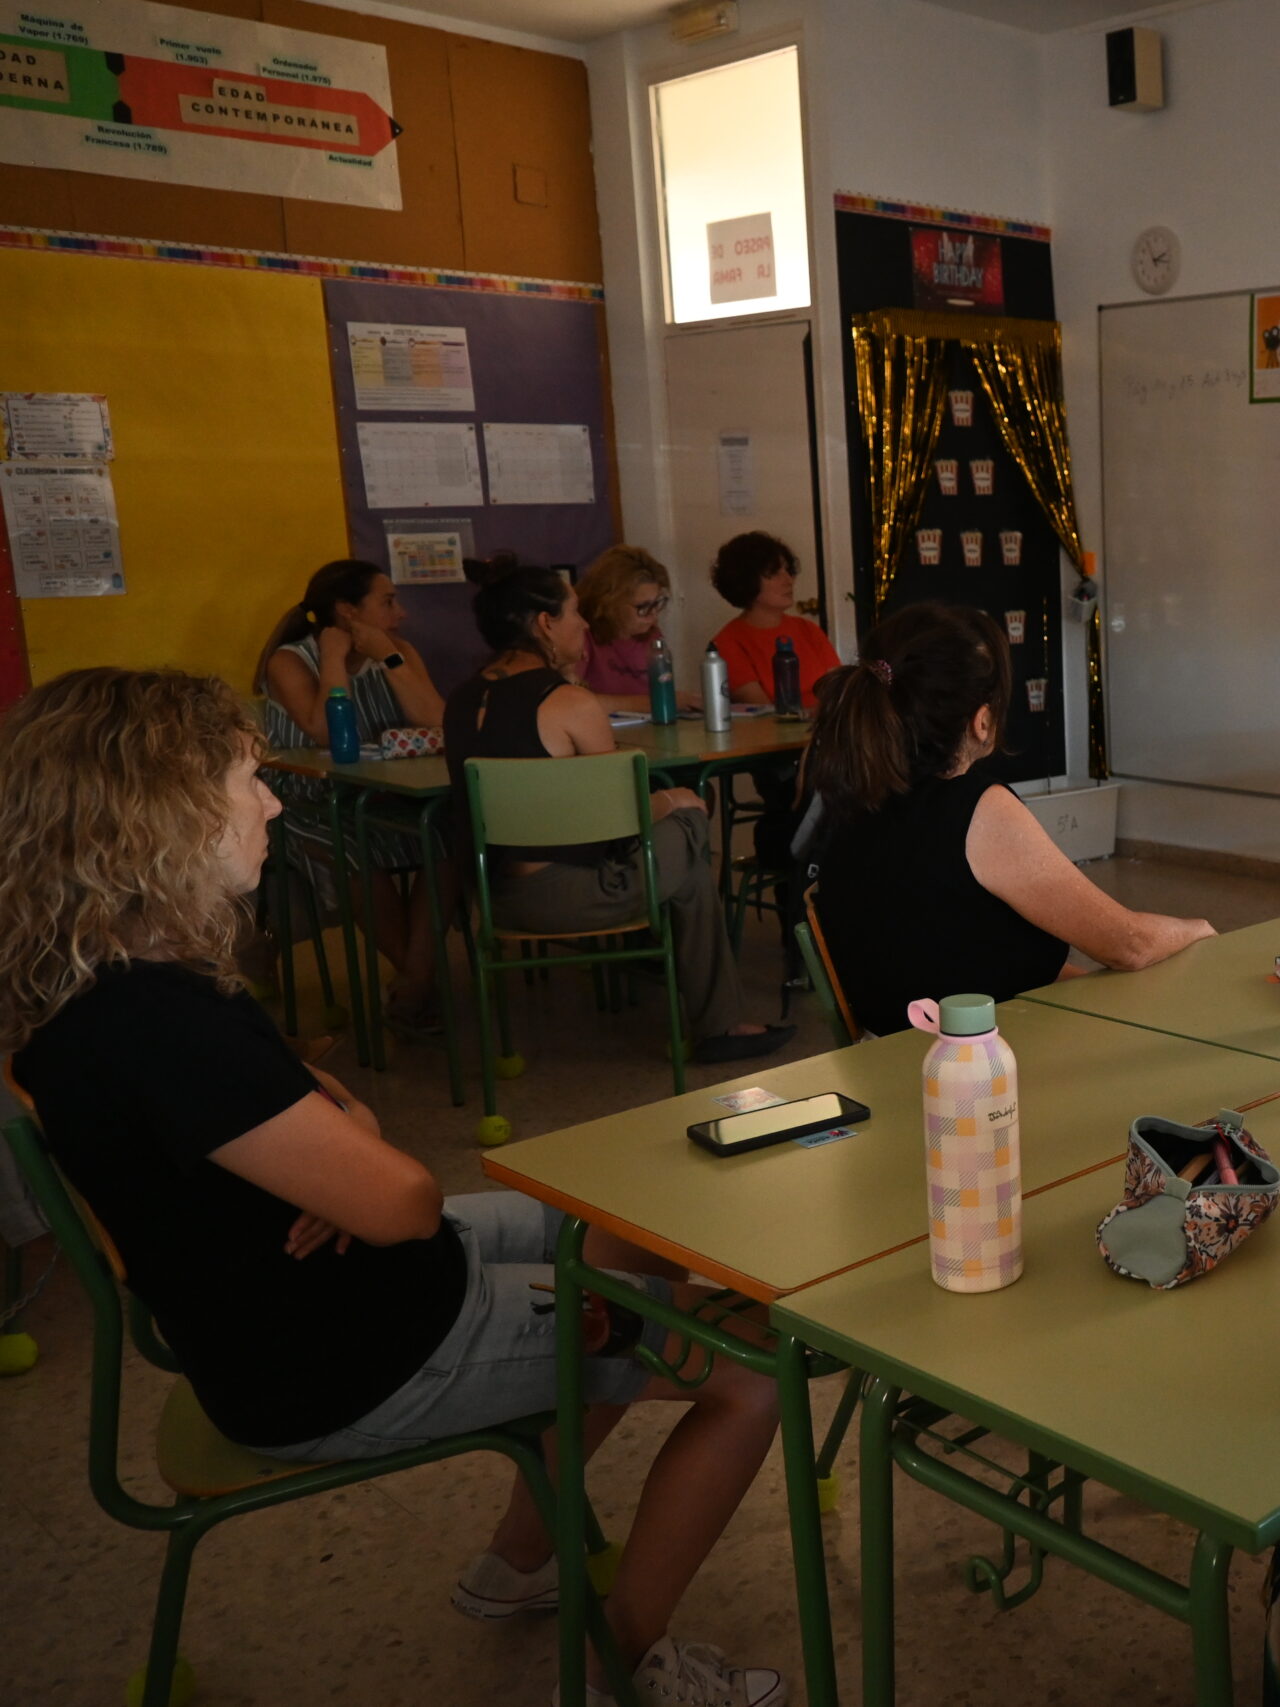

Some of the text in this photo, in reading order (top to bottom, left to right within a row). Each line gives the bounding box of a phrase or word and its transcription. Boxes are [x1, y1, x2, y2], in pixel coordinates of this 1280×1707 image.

[218, 86, 266, 103] EDAD
[191, 102, 355, 135] CONTEMPORÁNEA
[328, 154, 374, 167] Actualidad
[933, 262, 984, 288] BIRTHDAY
